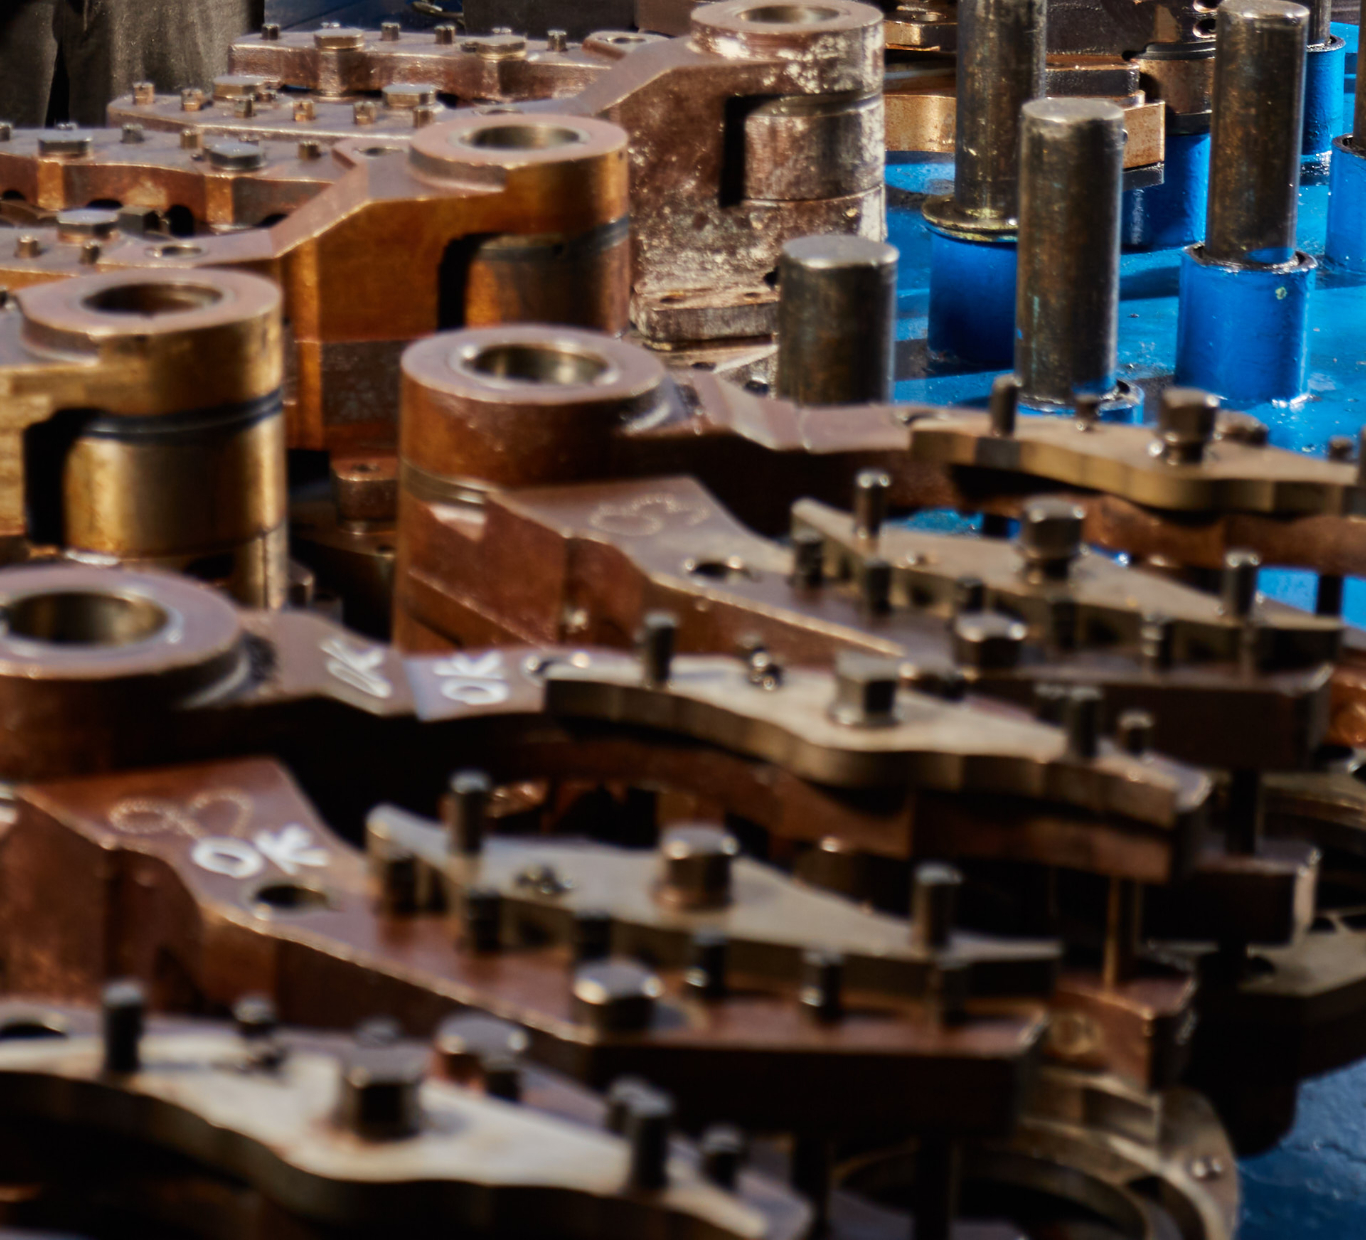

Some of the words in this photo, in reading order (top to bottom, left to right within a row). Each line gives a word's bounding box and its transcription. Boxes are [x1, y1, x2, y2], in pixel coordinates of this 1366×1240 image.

[319, 637, 392, 699] OK
[433, 650, 508, 705] OK
[191, 822, 330, 879] OK
